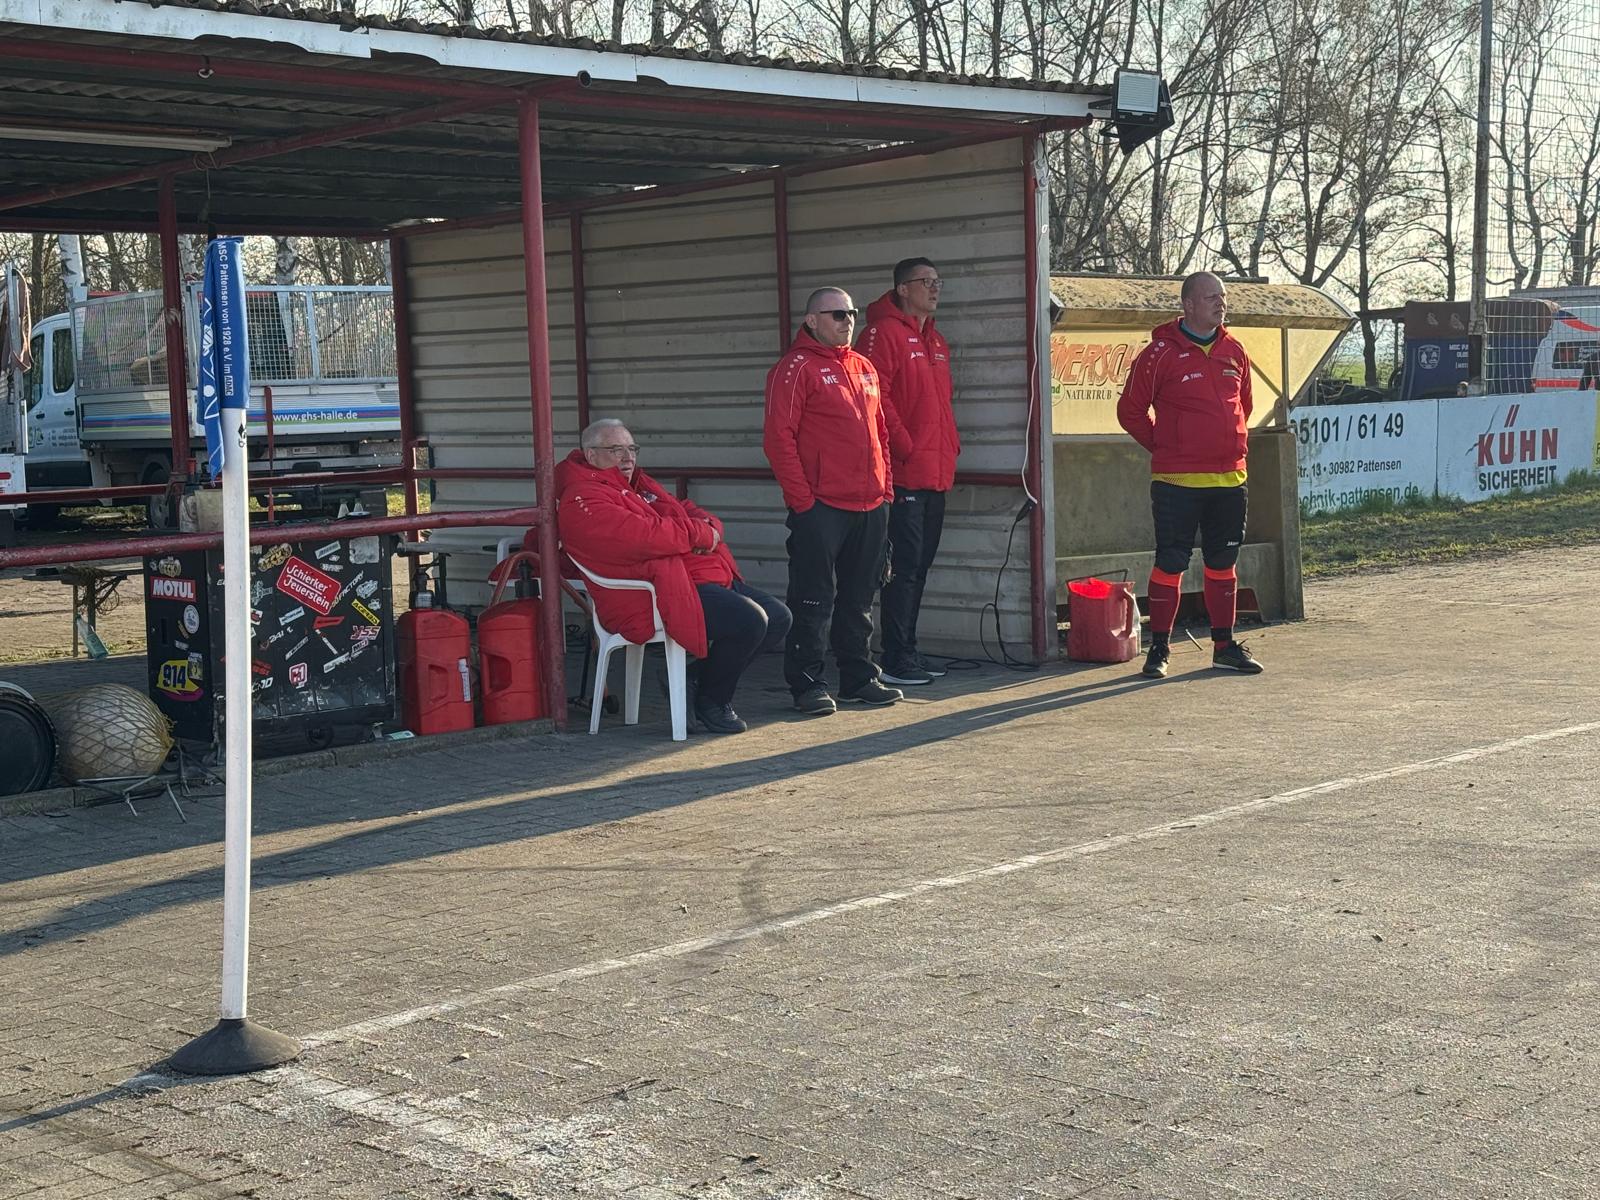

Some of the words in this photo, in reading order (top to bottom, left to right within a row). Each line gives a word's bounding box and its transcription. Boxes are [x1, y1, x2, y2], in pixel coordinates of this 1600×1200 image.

[217, 241, 228, 262] MSC
[220, 263, 229, 305] Pattensen
[223, 326, 231, 346] 1928
[224, 363, 232, 374] im
[822, 374, 839, 385] ME
[272, 409, 358, 423] www.ghs-halle.de
[1357, 413, 1377, 440] 61
[1383, 412, 1404, 438] 49
[1477, 403, 1558, 467] KÜHN
[1297, 464, 1309, 479] tr.
[1311, 462, 1321, 477] 13
[1328, 460, 1355, 475] 30982
[1357, 459, 1402, 473] Pattensen
[1478, 465, 1557, 492] SICHERHEIT
[152, 579, 194, 599] MOTUL
[162, 664, 187, 689] 914
